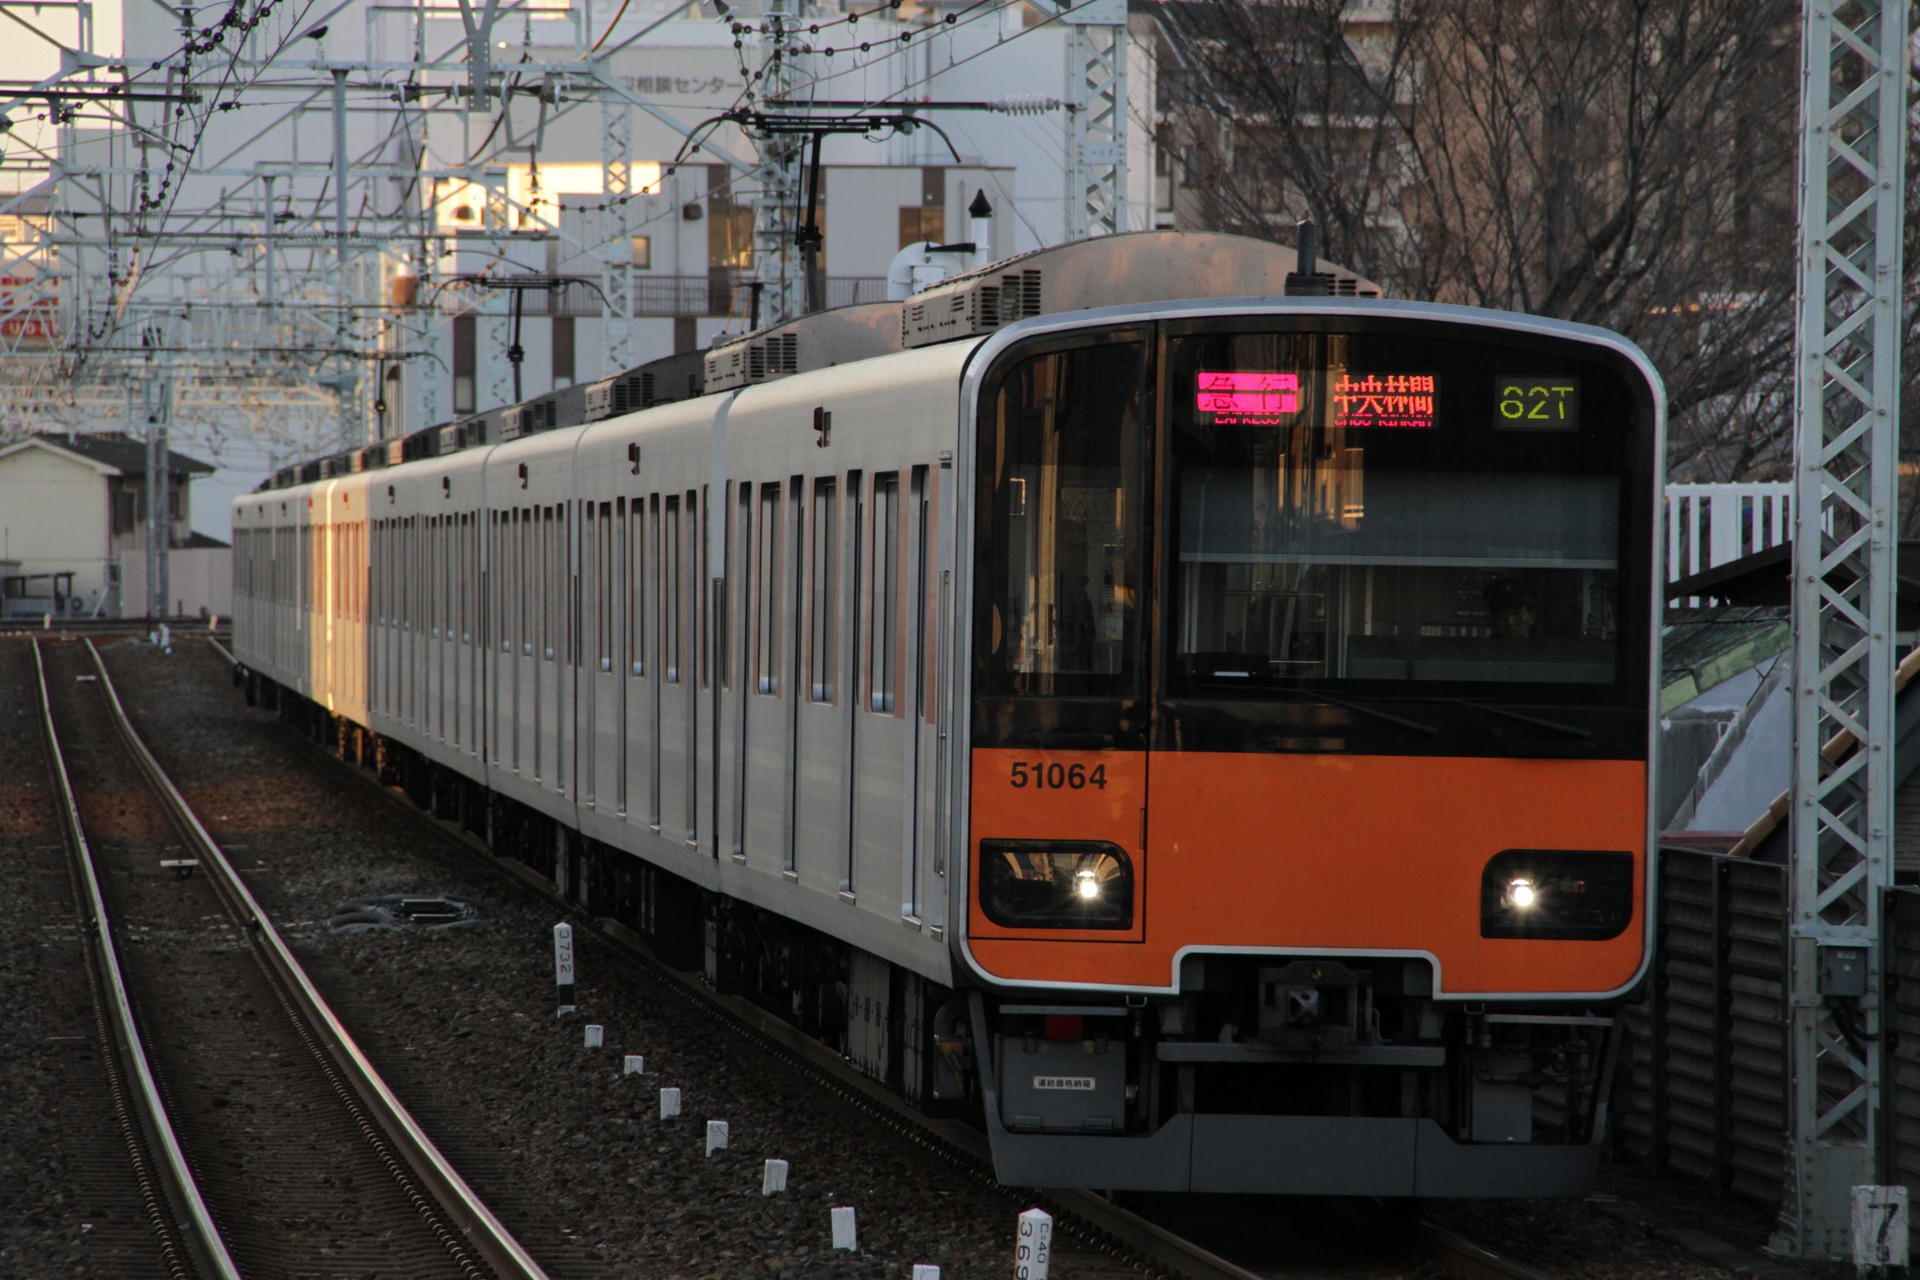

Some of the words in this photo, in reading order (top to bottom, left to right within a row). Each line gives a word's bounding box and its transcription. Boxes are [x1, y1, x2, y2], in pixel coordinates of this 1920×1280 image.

[1203, 373, 1291, 411] 急行
[1333, 374, 1435, 415] 中央林間
[1500, 385, 1574, 420] 62T
[1010, 761, 1108, 790] 51064
[559, 930, 572, 974] 3732
[1867, 1202, 1899, 1244] 7
